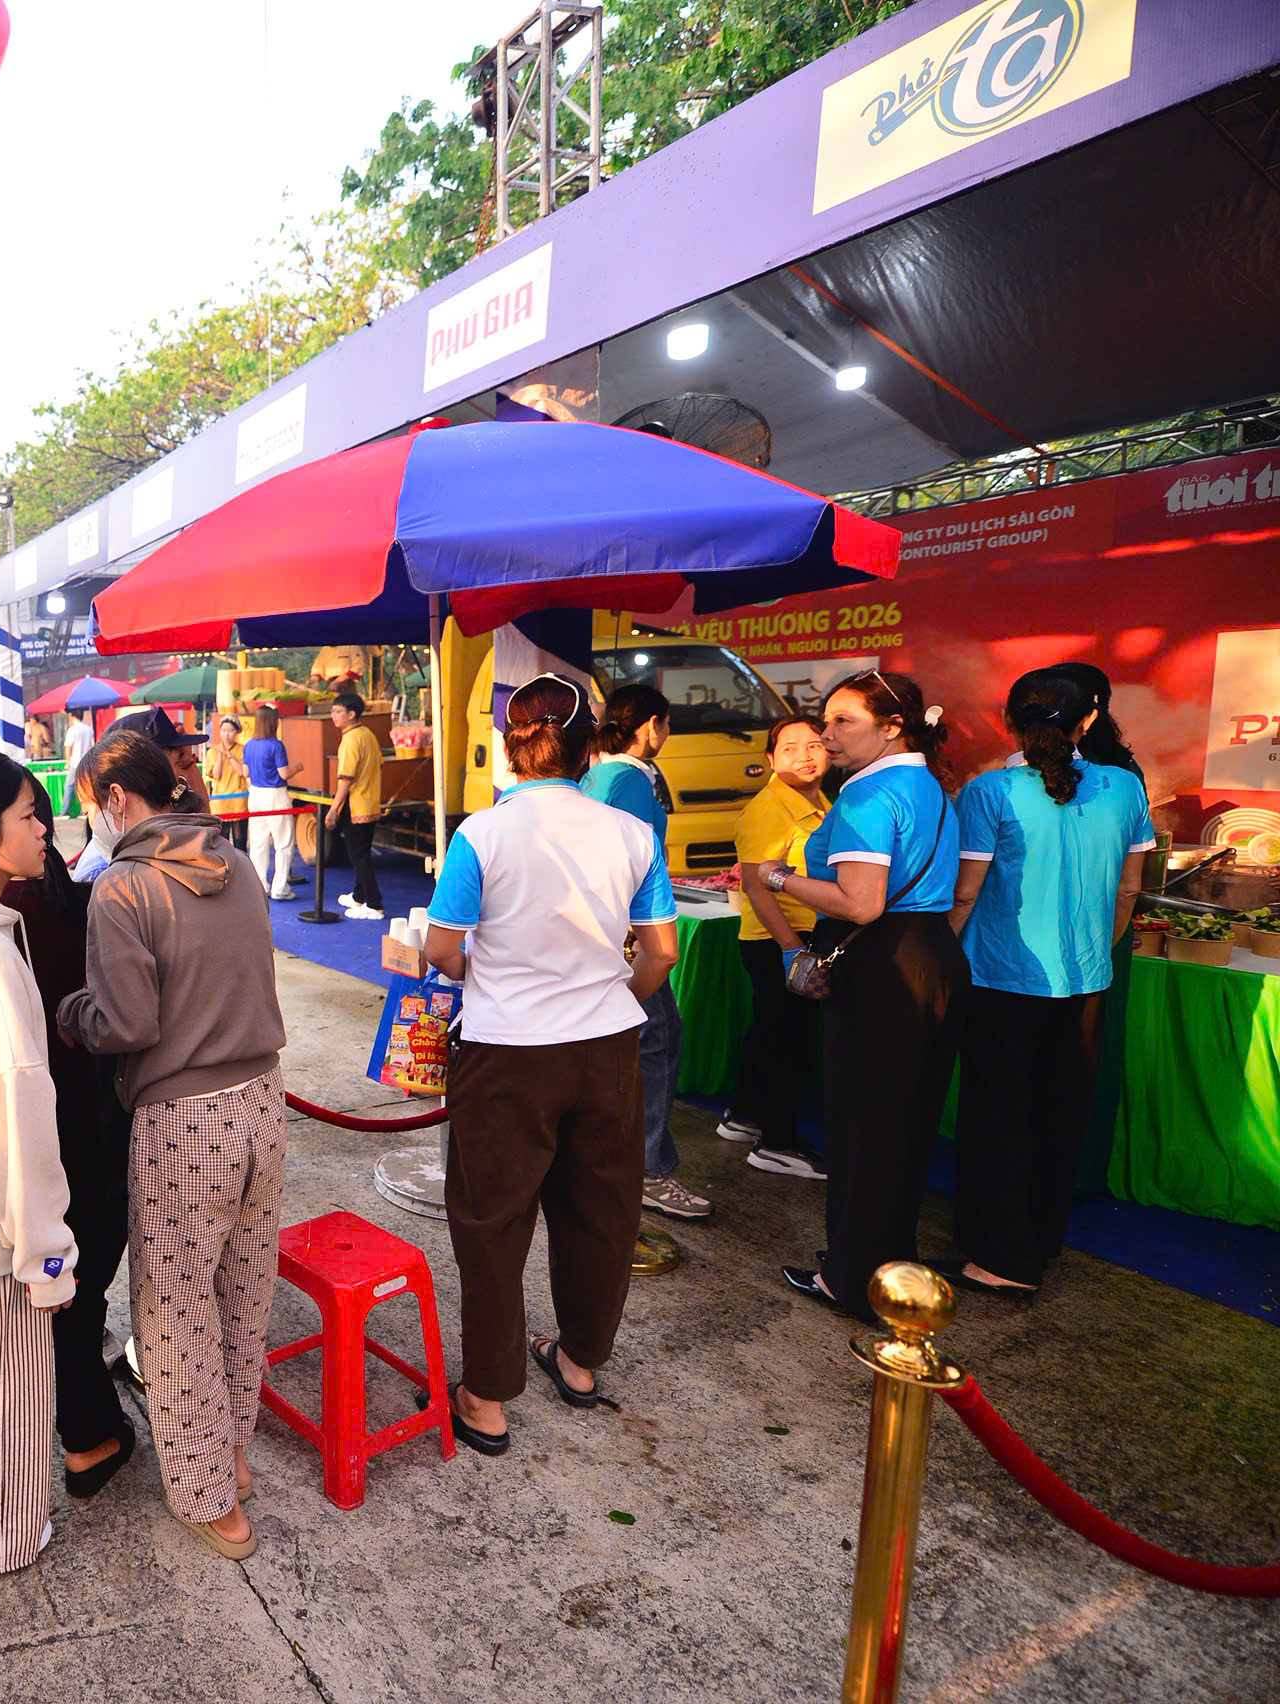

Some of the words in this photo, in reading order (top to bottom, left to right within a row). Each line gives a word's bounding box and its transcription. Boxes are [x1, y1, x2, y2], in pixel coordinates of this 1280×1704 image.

[483, 280, 533, 340] GIA
[902, 531, 923, 544] NG
[925, 527, 944, 541] TY
[946, 523, 968, 537] DU
[972, 517, 1005, 535] LỊCH
[1008, 511, 1034, 527] SÀI
[1037, 505, 1076, 522] GÒN
[987, 528, 1048, 549] GROUP)
[837, 601, 903, 632] 2026
[831, 635, 859, 651] LAO
